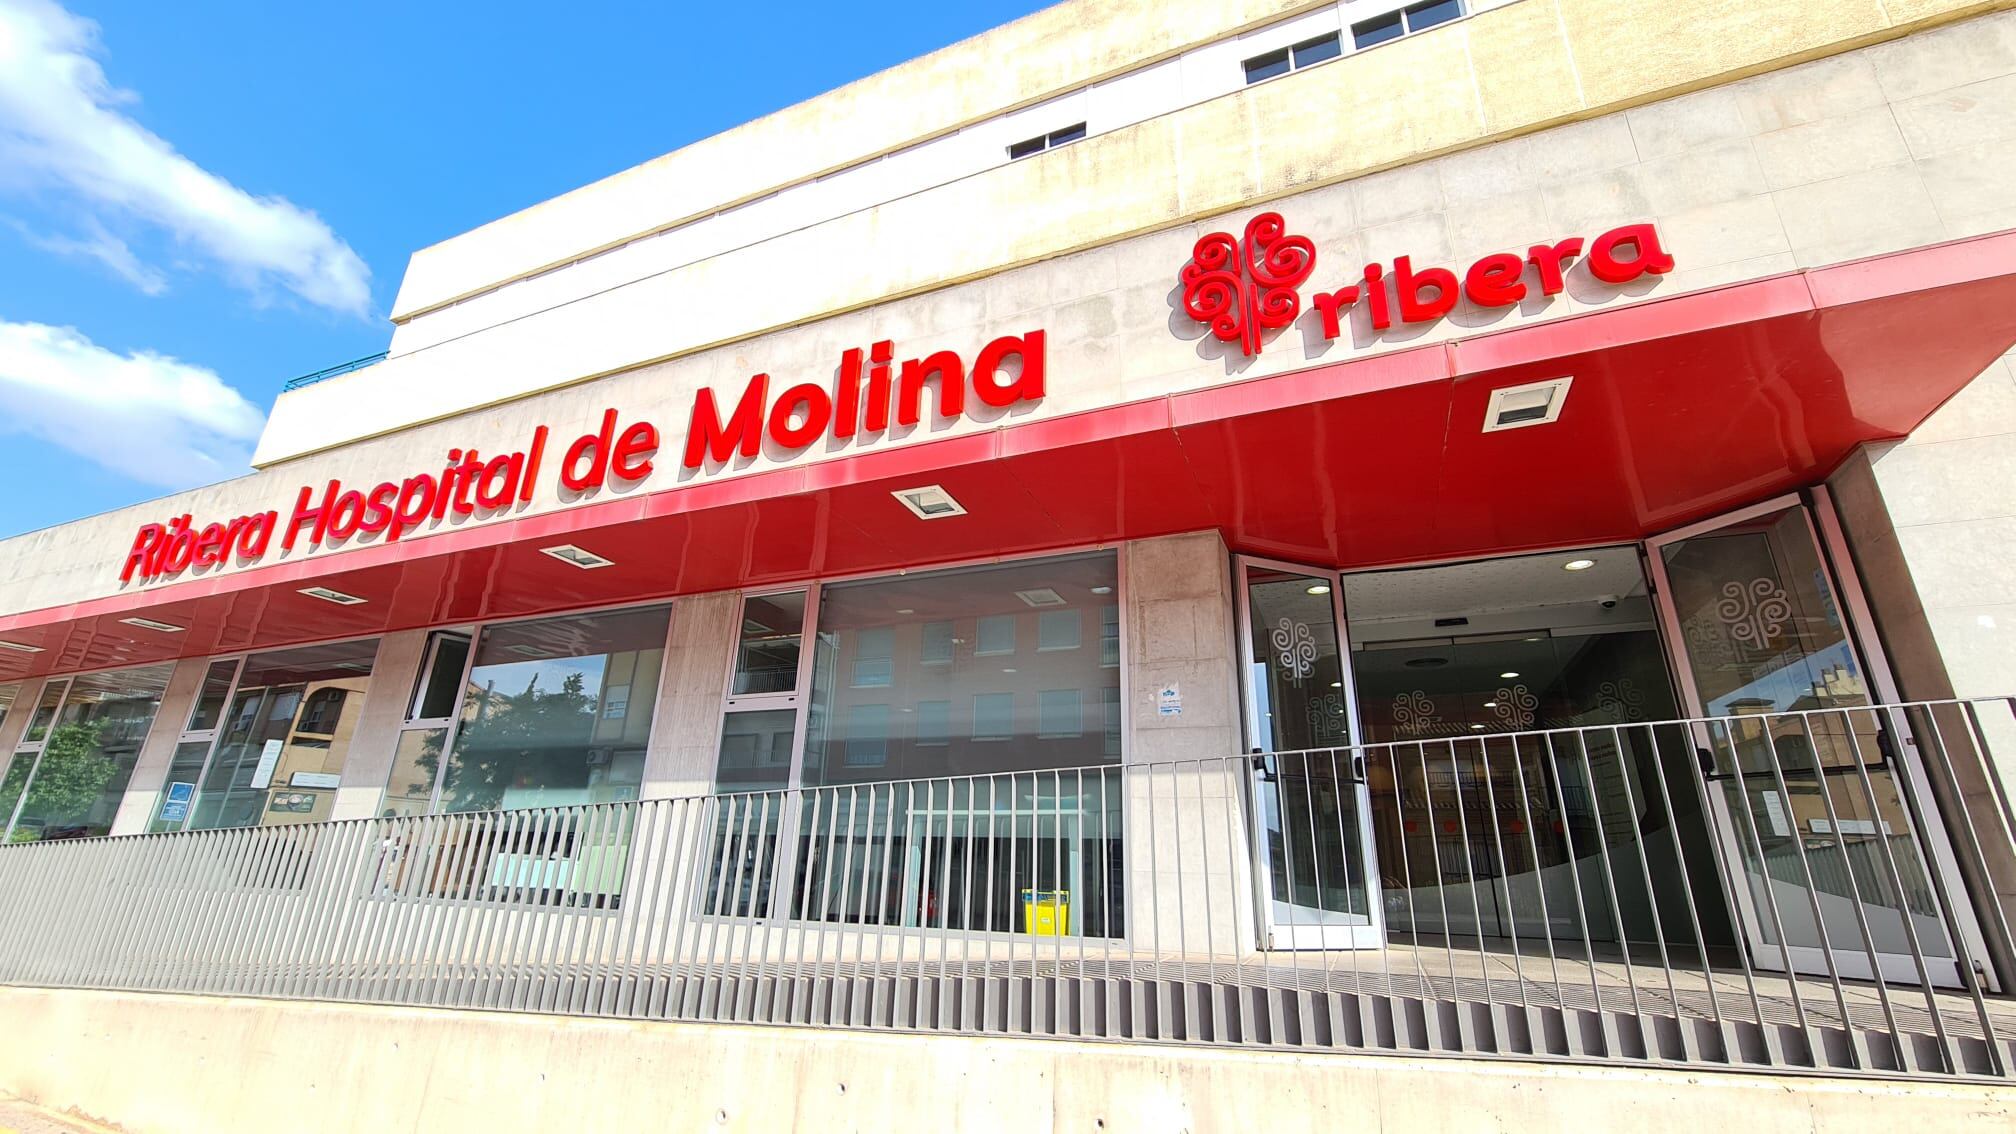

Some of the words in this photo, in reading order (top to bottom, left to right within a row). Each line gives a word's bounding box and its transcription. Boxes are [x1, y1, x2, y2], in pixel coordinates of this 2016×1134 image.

[1313, 223, 1675, 340] ribera
[119, 510, 278, 582] Ribera
[281, 425, 548, 542] Hospital
[561, 408, 659, 490] de
[684, 329, 1047, 468] Molina
